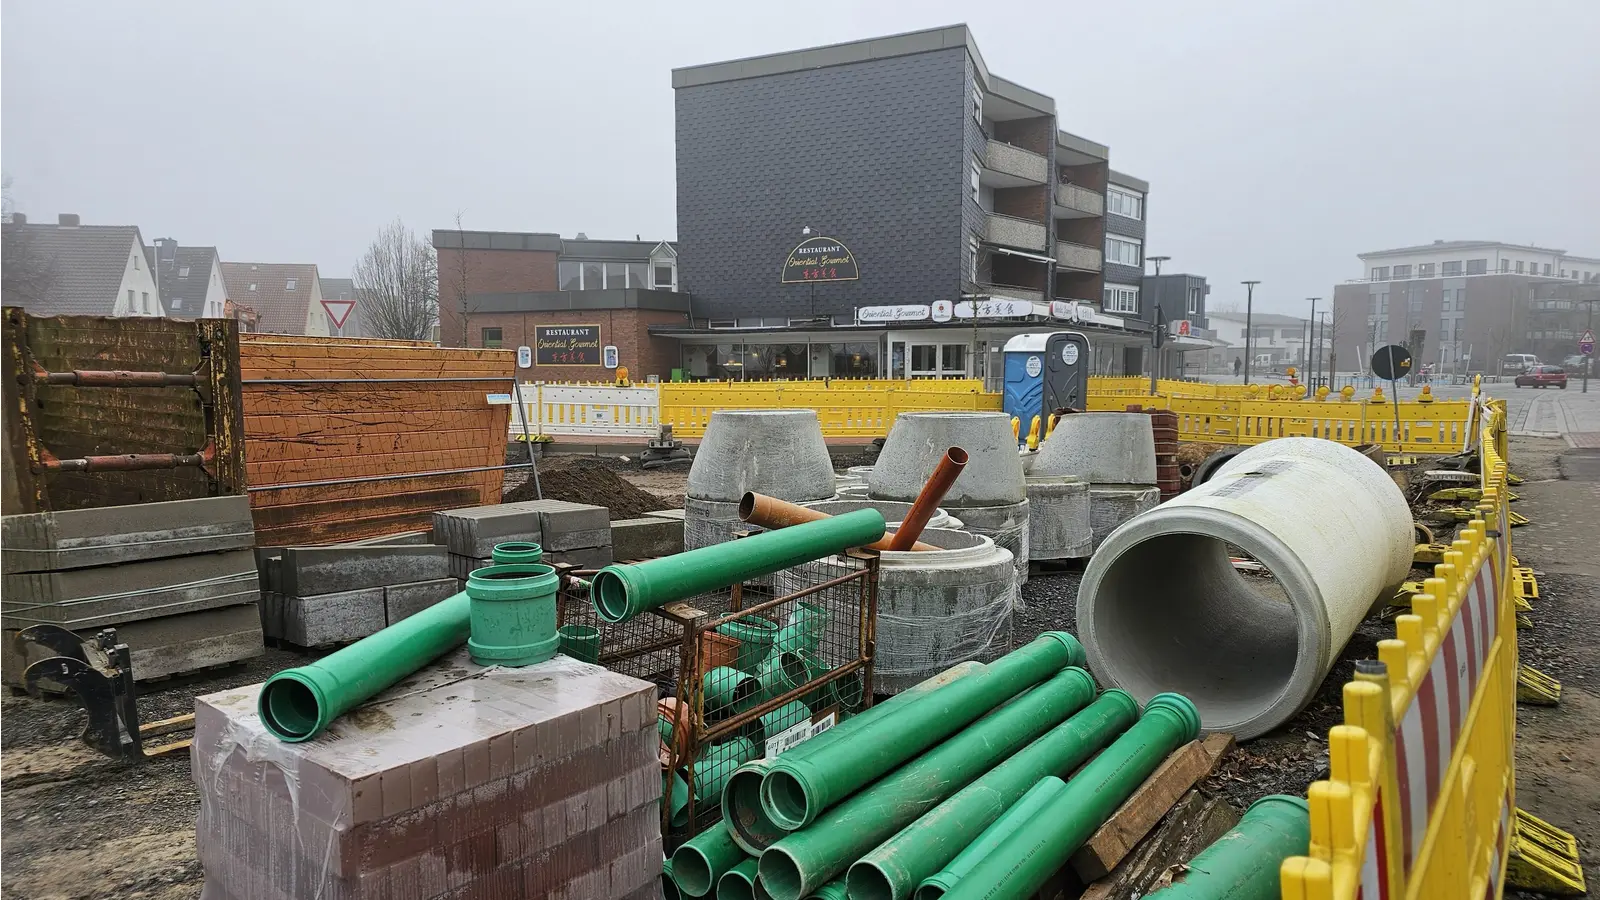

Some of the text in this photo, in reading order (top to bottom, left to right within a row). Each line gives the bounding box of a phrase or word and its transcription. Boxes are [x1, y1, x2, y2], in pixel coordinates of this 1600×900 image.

[798, 246, 840, 254] RESTAURANT
[819, 255, 850, 267] Gourmet
[894, 307, 926, 319] Gourmet
[545, 328, 590, 336] RESTAURANT
[568, 338, 598, 350] Gourmet
